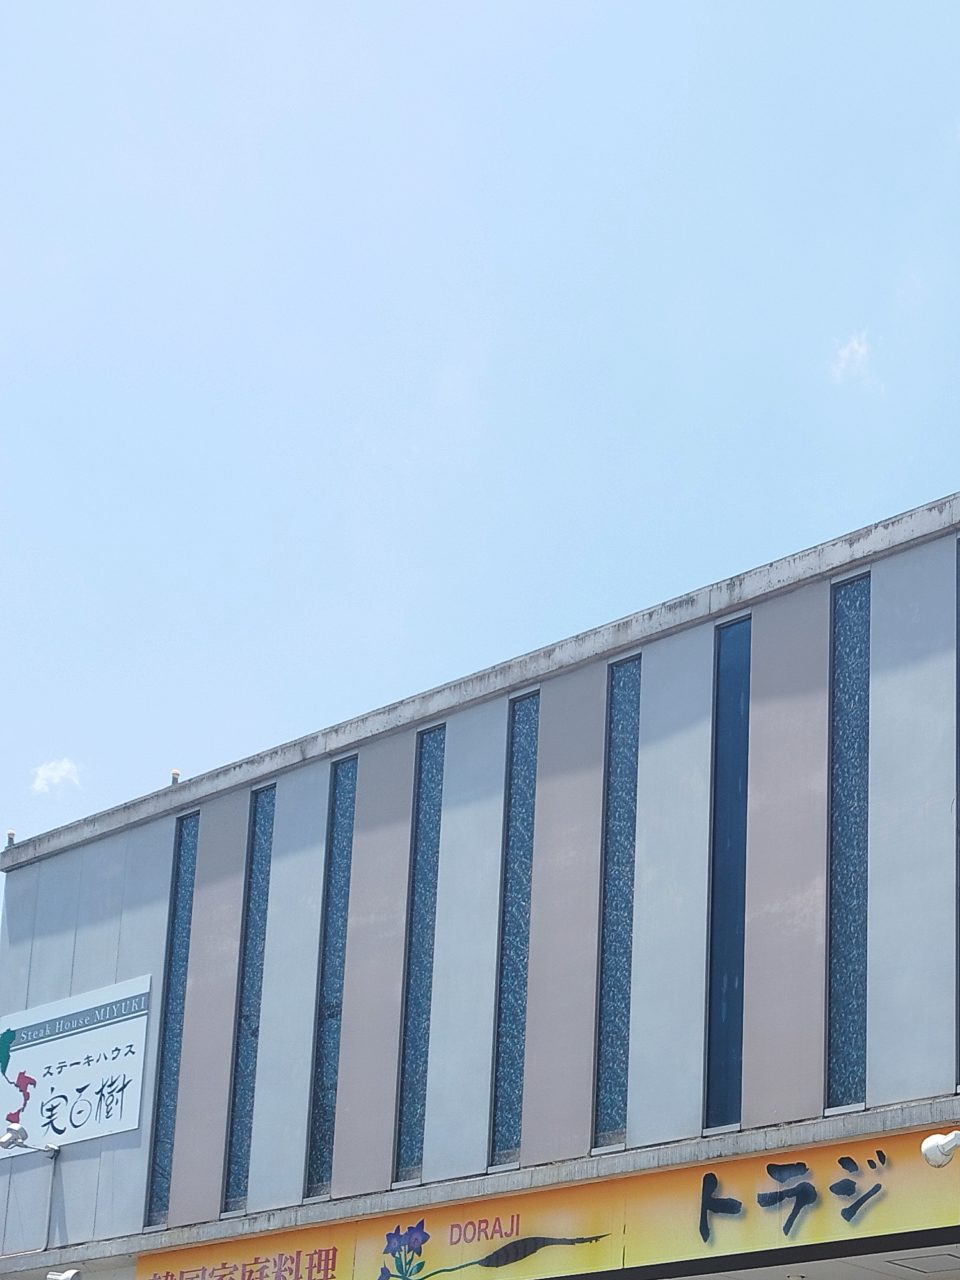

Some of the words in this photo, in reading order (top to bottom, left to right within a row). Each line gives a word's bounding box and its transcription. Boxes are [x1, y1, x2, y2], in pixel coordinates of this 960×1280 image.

[20, 1024, 51, 1042] Steak
[55, 1014, 91, 1033] House
[94, 996, 147, 1023] MIYUKI
[42, 1044, 136, 1078] ステーキハウス
[699, 1149, 887, 1244] トラジ
[448, 1213, 521, 1246] DORAJI
